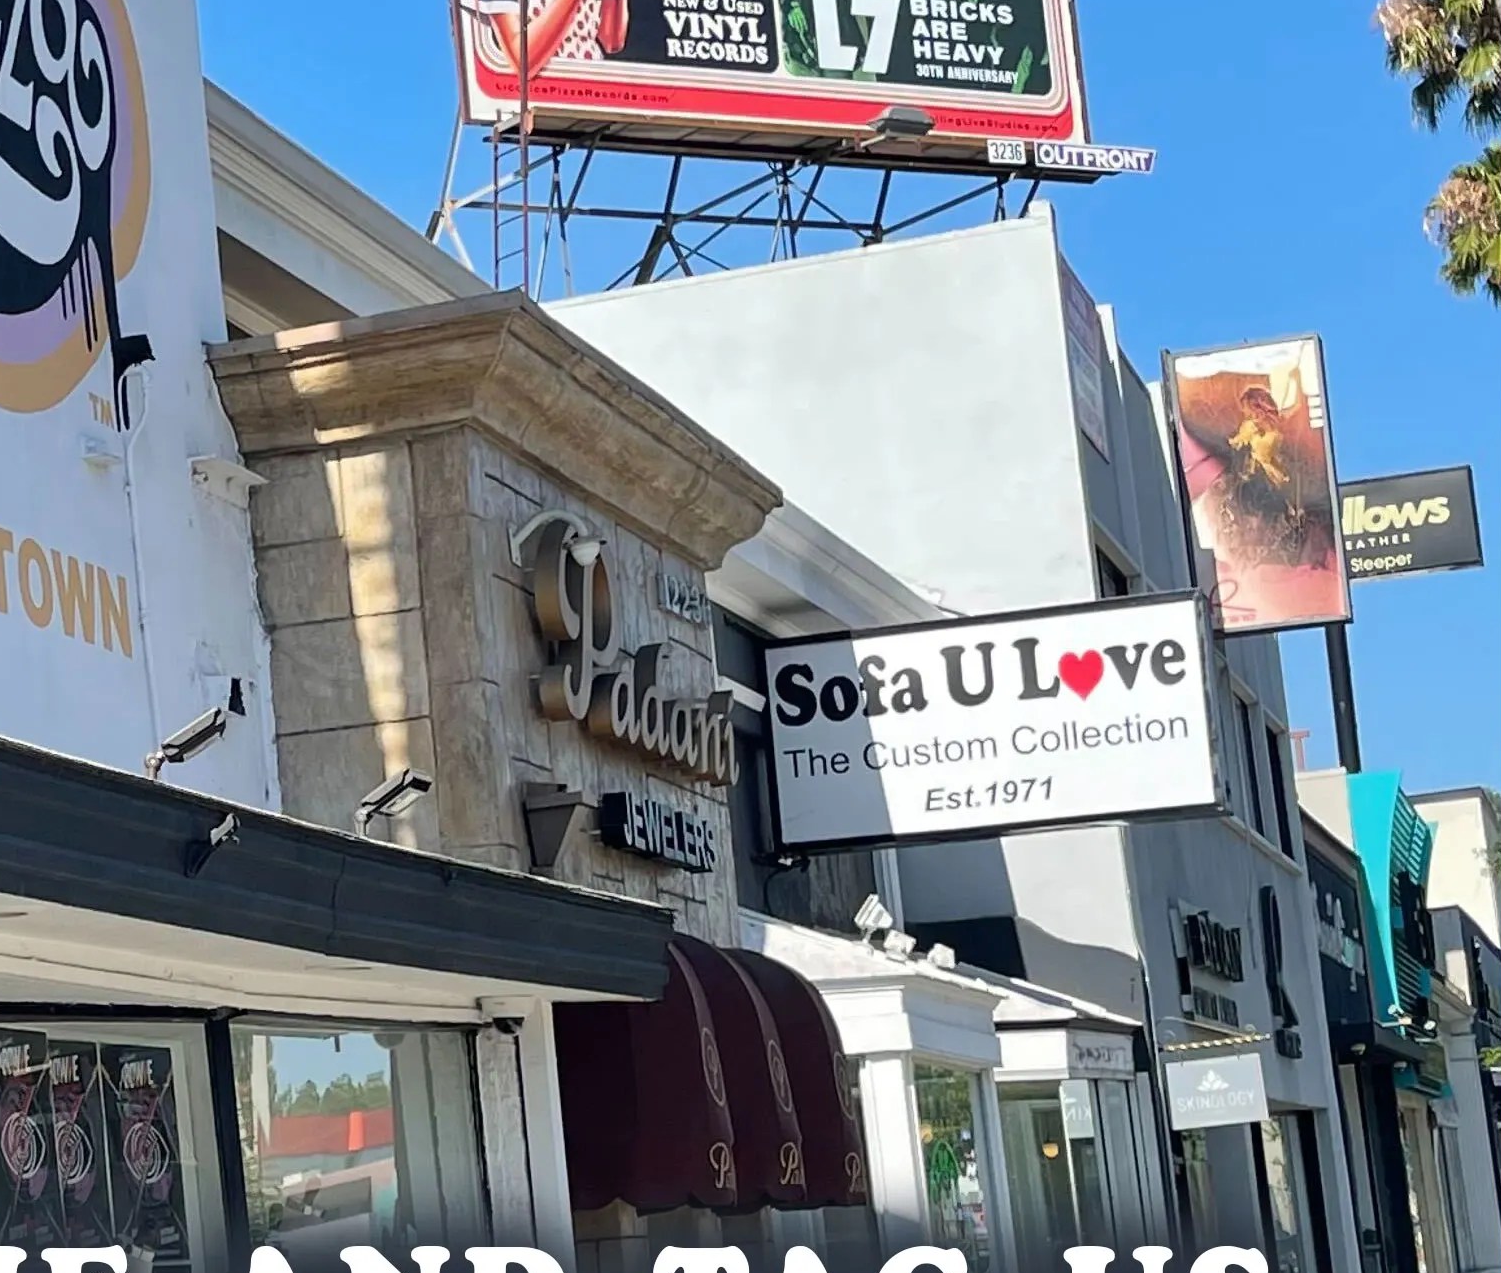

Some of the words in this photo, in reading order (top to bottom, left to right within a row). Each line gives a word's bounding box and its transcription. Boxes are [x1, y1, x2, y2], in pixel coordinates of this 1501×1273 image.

[663, 10, 767, 44] VINYL
[912, 18, 968, 41] ARE
[666, 38, 769, 66] RECORDS
[913, 39, 1005, 65] HEAVY
[915, 63, 944, 79] 30TH
[989, 141, 1023, 161] 3236
[543, 524, 740, 787] Padani
[774, 654, 929, 727] Sofa
[939, 641, 996, 707] U
[783, 748, 850, 779] The
[863, 730, 998, 771] Custom
[1011, 712, 1189, 756] Collection
[622, 792, 716, 871] JEWELERS
